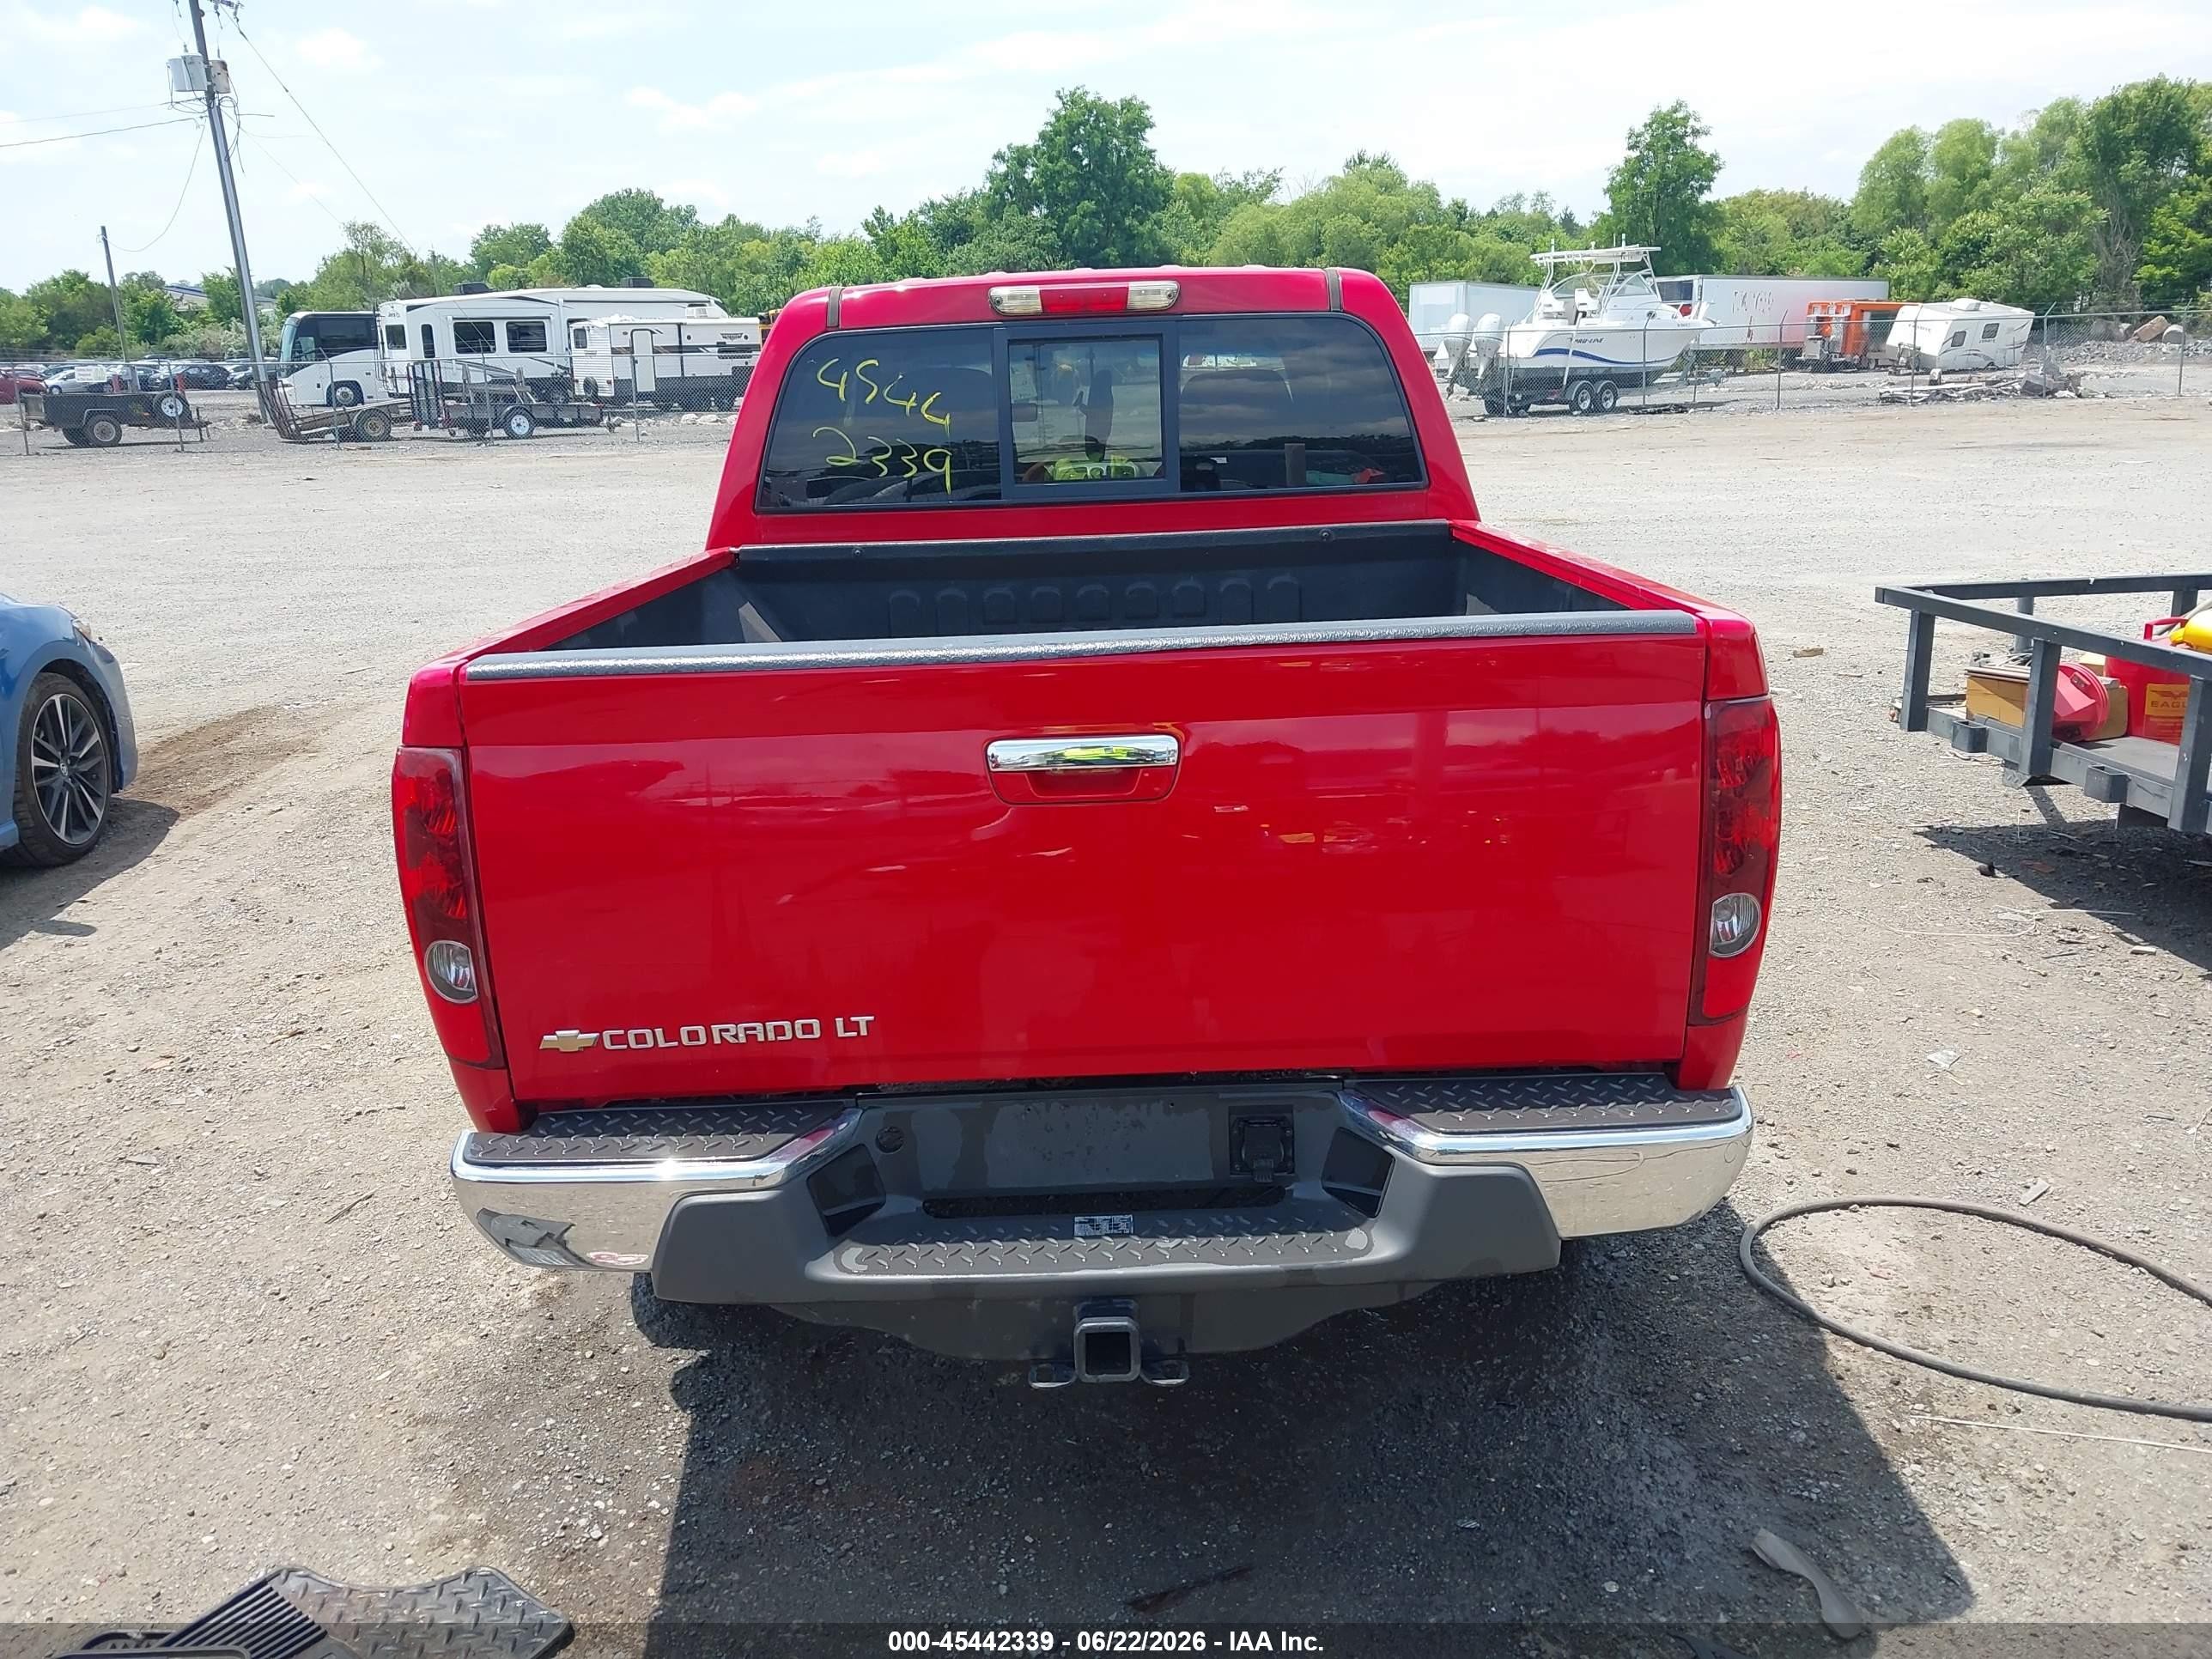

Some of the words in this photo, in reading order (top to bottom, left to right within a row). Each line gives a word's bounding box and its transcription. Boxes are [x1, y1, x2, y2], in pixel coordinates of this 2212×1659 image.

[817, 358, 951, 436] 4544
[812, 426, 953, 495] 2339
[2149, 700, 2188, 709] EAGL
[602, 1018, 822, 1051] COLORADO
[835, 1015, 876, 1038] LT
